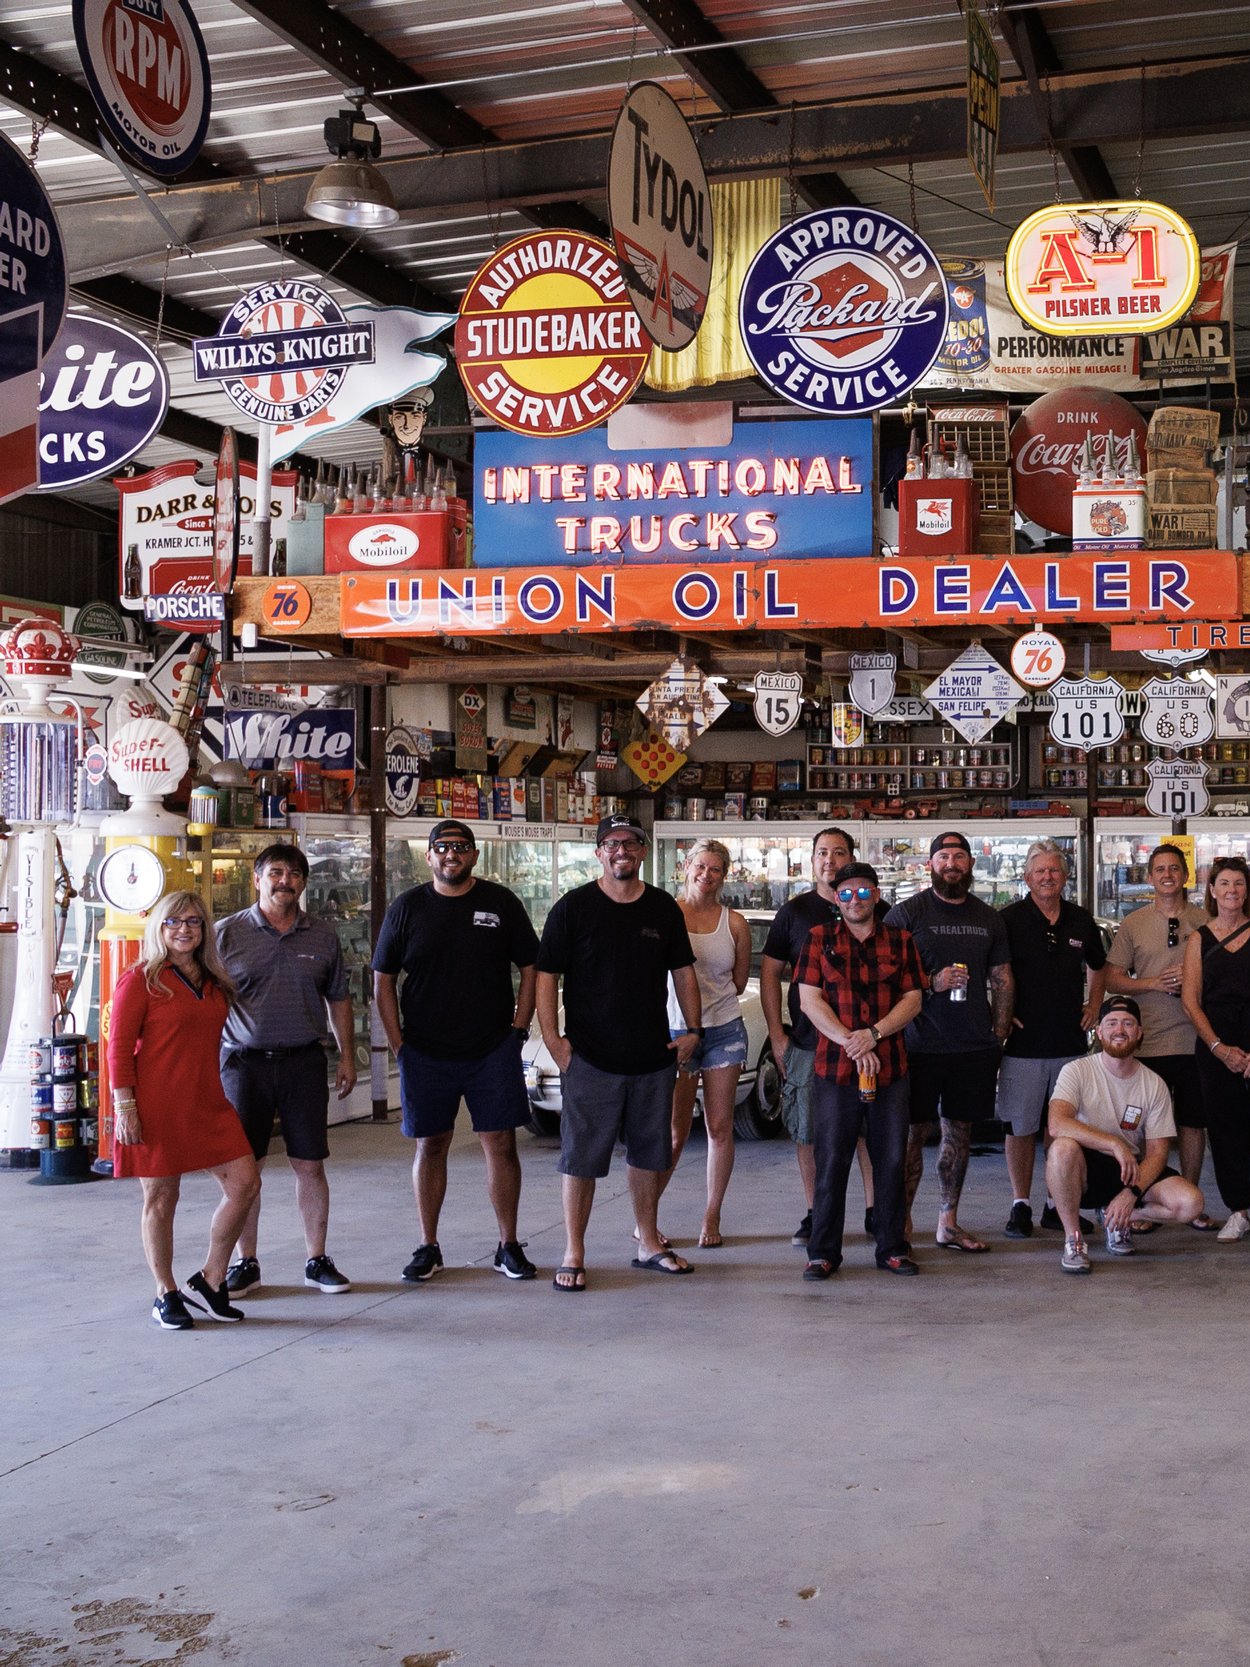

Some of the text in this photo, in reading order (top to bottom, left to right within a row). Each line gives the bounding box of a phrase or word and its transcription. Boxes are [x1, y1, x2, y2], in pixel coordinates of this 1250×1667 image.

[114, 6, 183, 111] RPM
[111, 101, 182, 157] MOTOR OIL
[627, 107, 709, 262] TYDOL
[774, 217, 928, 280] APPROVED
[1026, 226, 1168, 294] A-1
[479, 241, 626, 309] AUTHORIZED
[233, 282, 332, 320] SERVICE
[749, 281, 938, 337] Packard
[1046, 295, 1161, 318] PILSNER BEER
[468, 311, 642, 357] STUDEBAKER
[1150, 326, 1226, 358] WAR
[198, 331, 371, 372] WILLYS KNIGHT
[997, 336, 1125, 359] PERFORMANCE
[38, 345, 156, 412] ite
[767, 350, 907, 406] SERVICE
[994, 366, 1082, 376] GREATER GASOLINE
[230, 375, 339, 421] GENUINE PARTS
[479, 365, 629, 428] SERVICE
[1057, 412, 1099, 424] DRINK
[39, 430, 106, 464] CKS
[483, 456, 862, 504] INTERNATIONAL
[137, 495, 198, 523] DARR
[1151, 514, 1178, 529] WAR
[185, 519, 206, 529] Since
[556, 511, 779, 554] TRUCKS
[919, 520, 951, 530] Mobiloil
[146, 537, 182, 549] KRAMER
[184, 536, 201, 548] JCT.
[359, 545, 408, 558] Mobiloil
[146, 594, 224, 619] PORSCHE
[272, 591, 299, 616] 76
[385, 560, 1196, 629] UNION OIL DEALER
[85, 652, 118, 666] GASOLINE
[853, 655, 892, 669] MEXICO
[1024, 648, 1053, 675] 76
[760, 676, 796, 689] MEXICO
[870, 678, 876, 701] 1
[939, 676, 982, 686] EL MAYOR
[939, 687, 980, 697] MEXICALI
[1060, 686, 1115, 697] CALIFORNIA
[1151, 686, 1207, 696] CALIFORNIA
[241, 690, 299, 711] TELEPHONE
[464, 694, 480, 706] DX
[765, 697, 790, 725] 15
[938, 701, 987, 711] SAN FELIPE
[228, 713, 352, 760] White
[1062, 711, 1113, 739] 101
[1156, 711, 1199, 738] 60
[112, 736, 159, 762] Super
[124, 757, 171, 772] SHELL
[1154, 765, 1202, 776] CALIFORNIA
[1161, 791, 1196, 814] 101
[504, 825, 553, 838] MOUSE'S MOUSE TRAPS
[26, 853, 34, 930] VISIBLE
[940, 925, 989, 937] REALTRUCK
